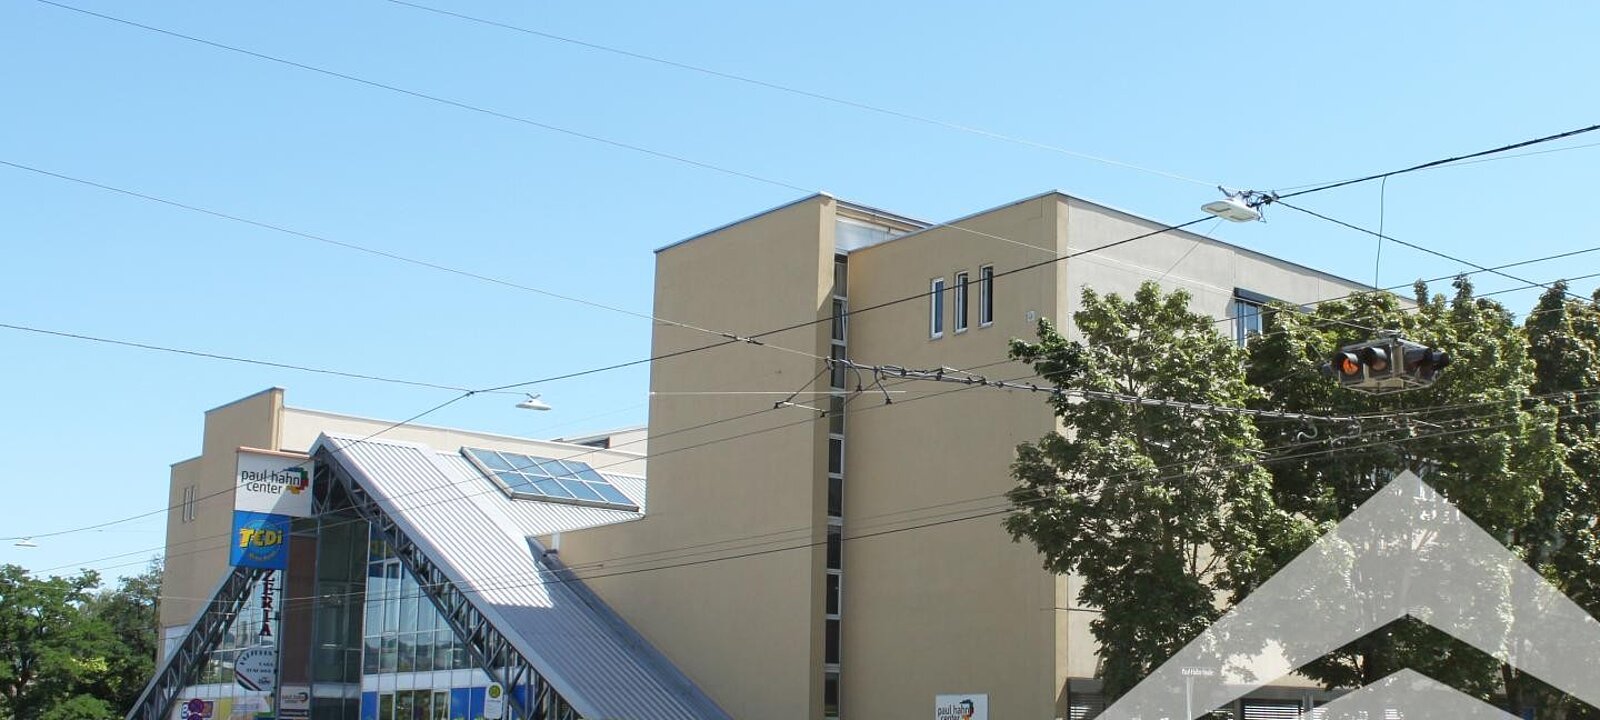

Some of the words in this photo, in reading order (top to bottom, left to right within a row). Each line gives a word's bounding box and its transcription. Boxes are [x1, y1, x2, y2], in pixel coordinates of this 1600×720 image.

[241, 469, 267, 482] paul
[271, 470, 300, 485] hahn
[246, 481, 282, 494] center
[937, 704, 952, 717] paul
